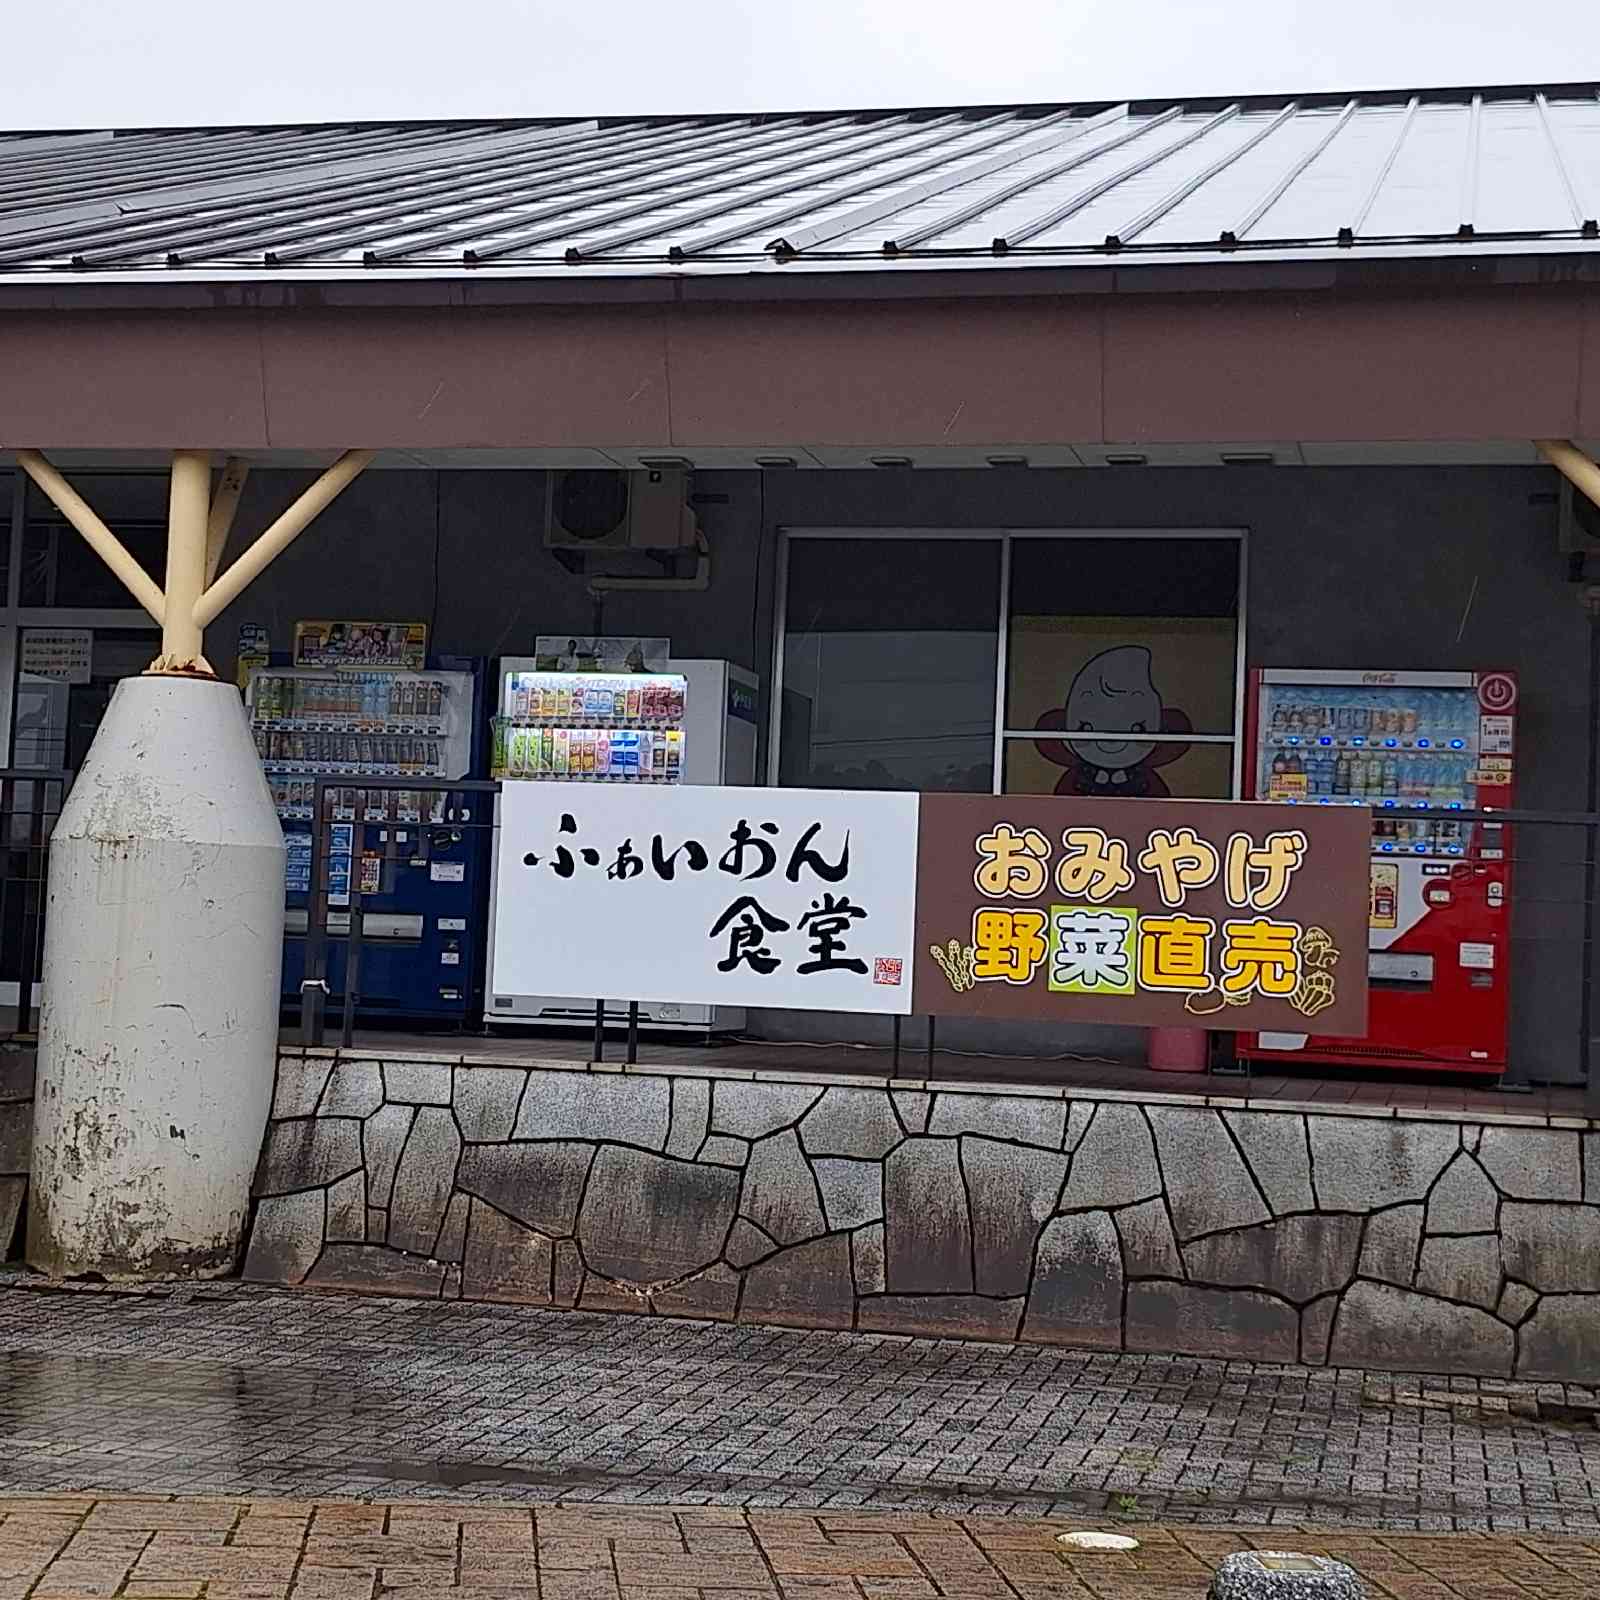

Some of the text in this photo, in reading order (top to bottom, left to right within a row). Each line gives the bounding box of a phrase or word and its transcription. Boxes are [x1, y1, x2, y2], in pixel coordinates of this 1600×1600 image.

[523, 813, 850, 883] ふぁいおん
[974, 824, 1307, 911] おみやげ
[709, 892, 869, 975] 食堂
[972, 907, 1301, 997] 野菜直売
